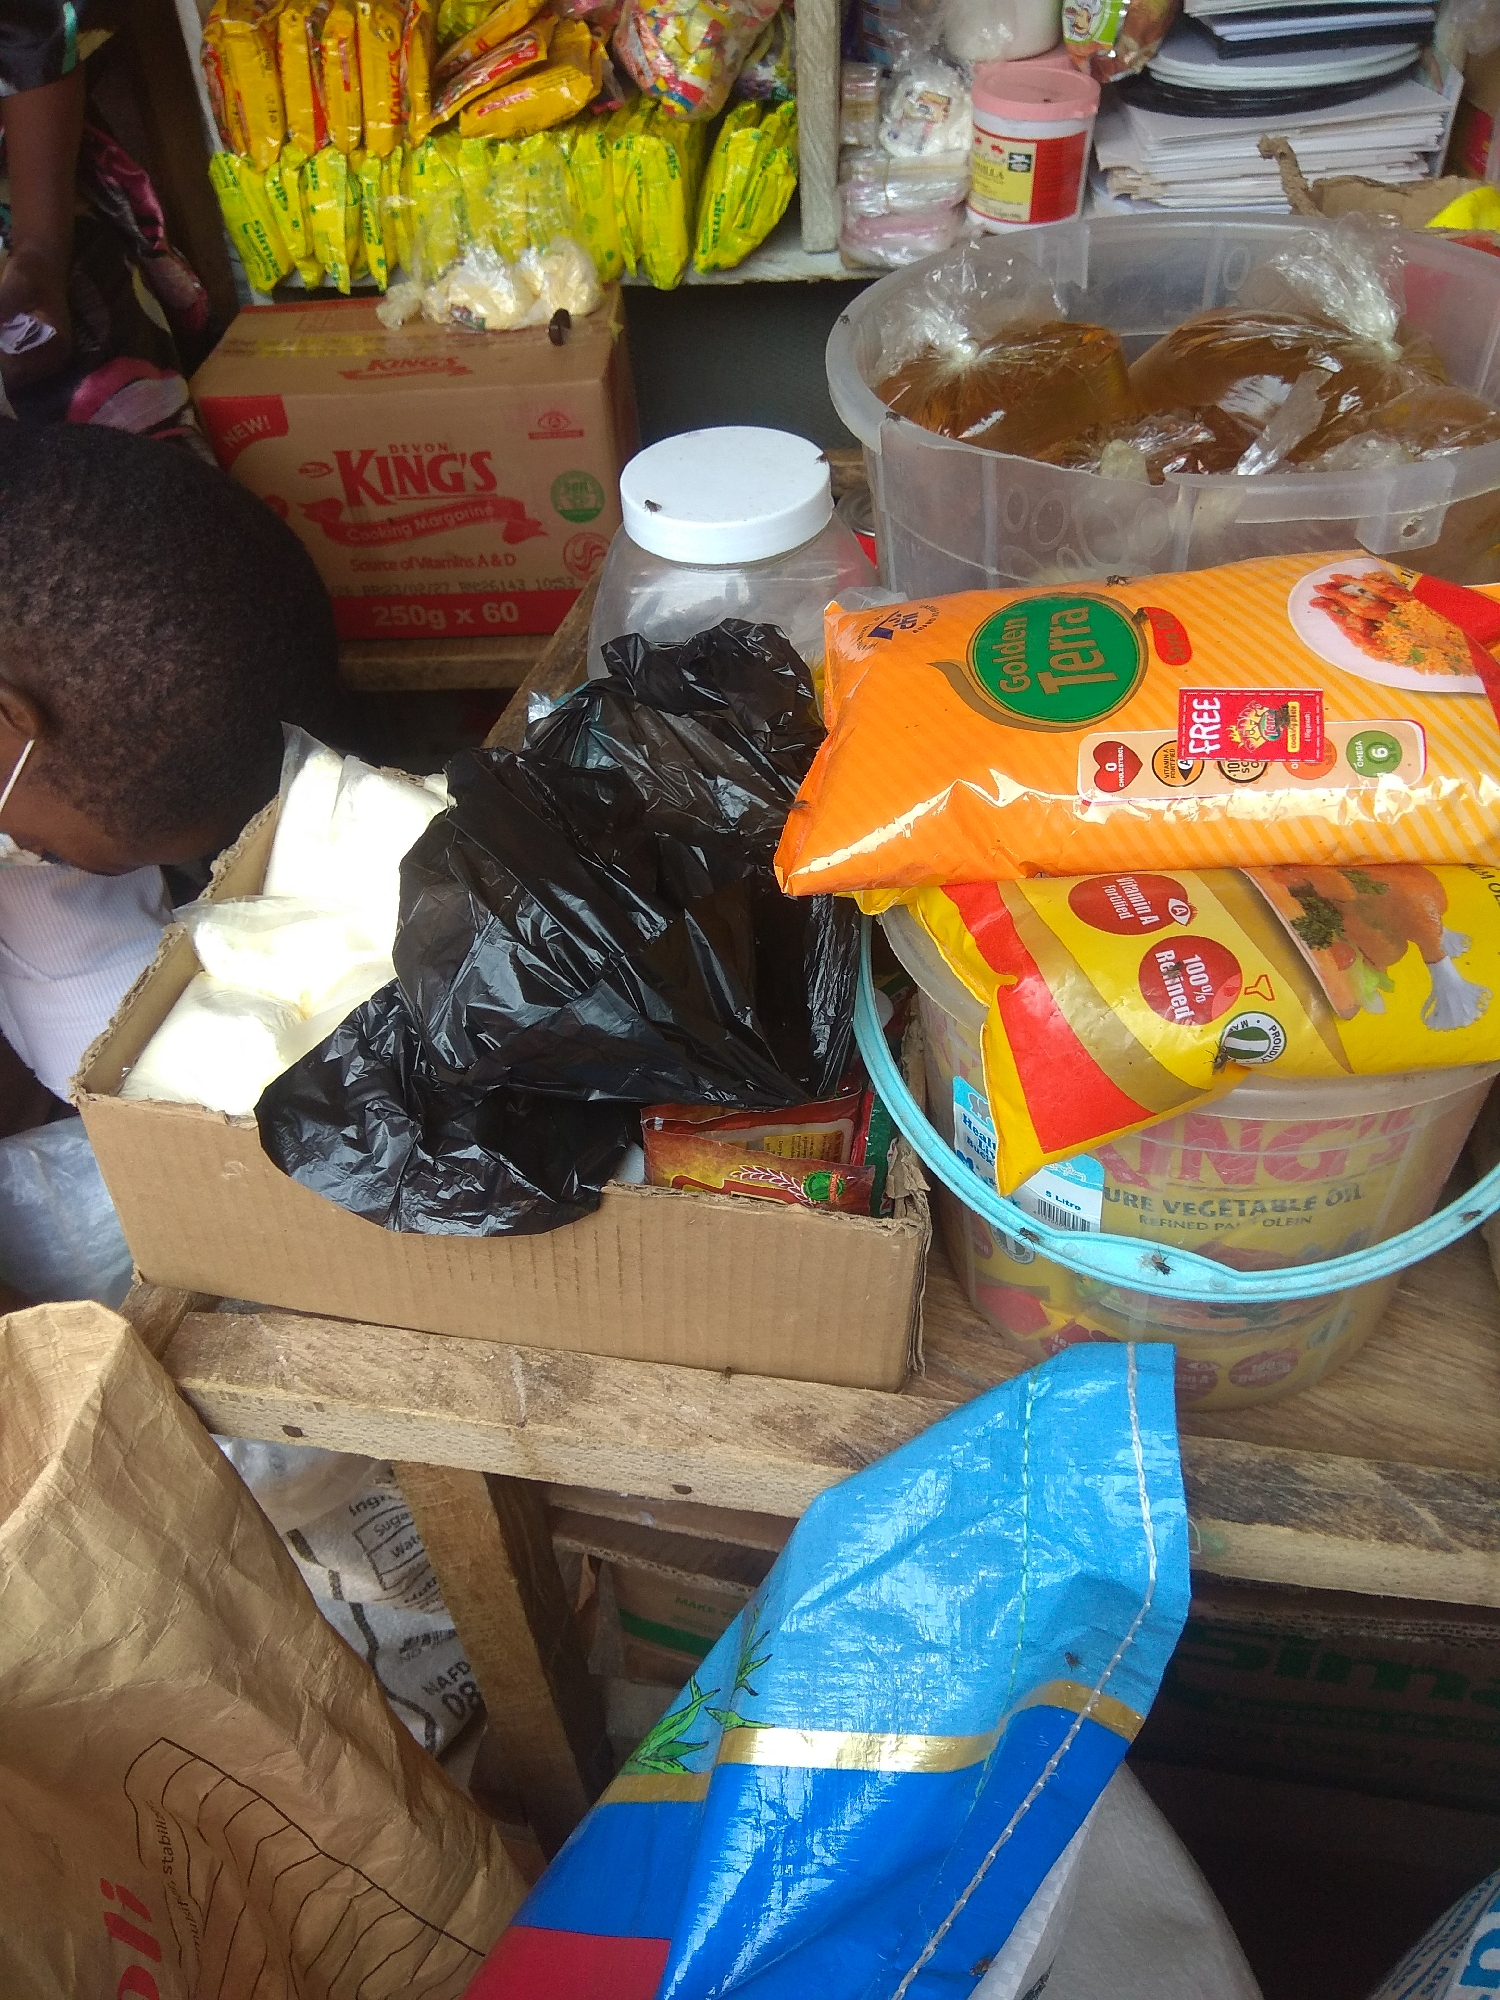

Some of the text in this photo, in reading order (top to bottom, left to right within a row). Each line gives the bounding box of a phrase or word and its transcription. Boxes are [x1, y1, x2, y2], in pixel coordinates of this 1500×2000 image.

[222, 414, 272, 449] NEW!
[388, 442, 449, 454] DEVON
[333, 449, 497, 508] KING'S
[346, 503, 495, 542] Cooking Margarine
[477, 554, 488, 567] A
[491, 553, 502, 567] &
[504, 552, 517, 566] D
[372, 601, 519, 630] 250g x 60
[992, 616, 1032, 694] Golden
[1036, 606, 1119, 695] Terra
[1188, 697, 1222, 755] FREE
[1105, 762, 1117, 772] 0
[1117, 745, 1125, 788] CHOLESTEROL
[1169, 748, 1177, 778] FORTIFIED
[1355, 740, 1364, 767] OMEGA
[1371, 747, 1389, 759] 6
[1101, 884, 1135, 921] Fortified
[1116, 876, 1160, 926] Vitamin A
[1183, 953, 1215, 1004] 100%
[1260, 1024, 1282, 1063] PROUDLY
[966, 1136, 995, 1167] Buck
[1101, 1183, 1364, 1218] URE VEGETABLE OIL
[1138, 1213, 1209, 1231] REFINED
[1262, 1214, 1313, 1228] OLEIN
[421, 1659, 472, 1697] NAFD
